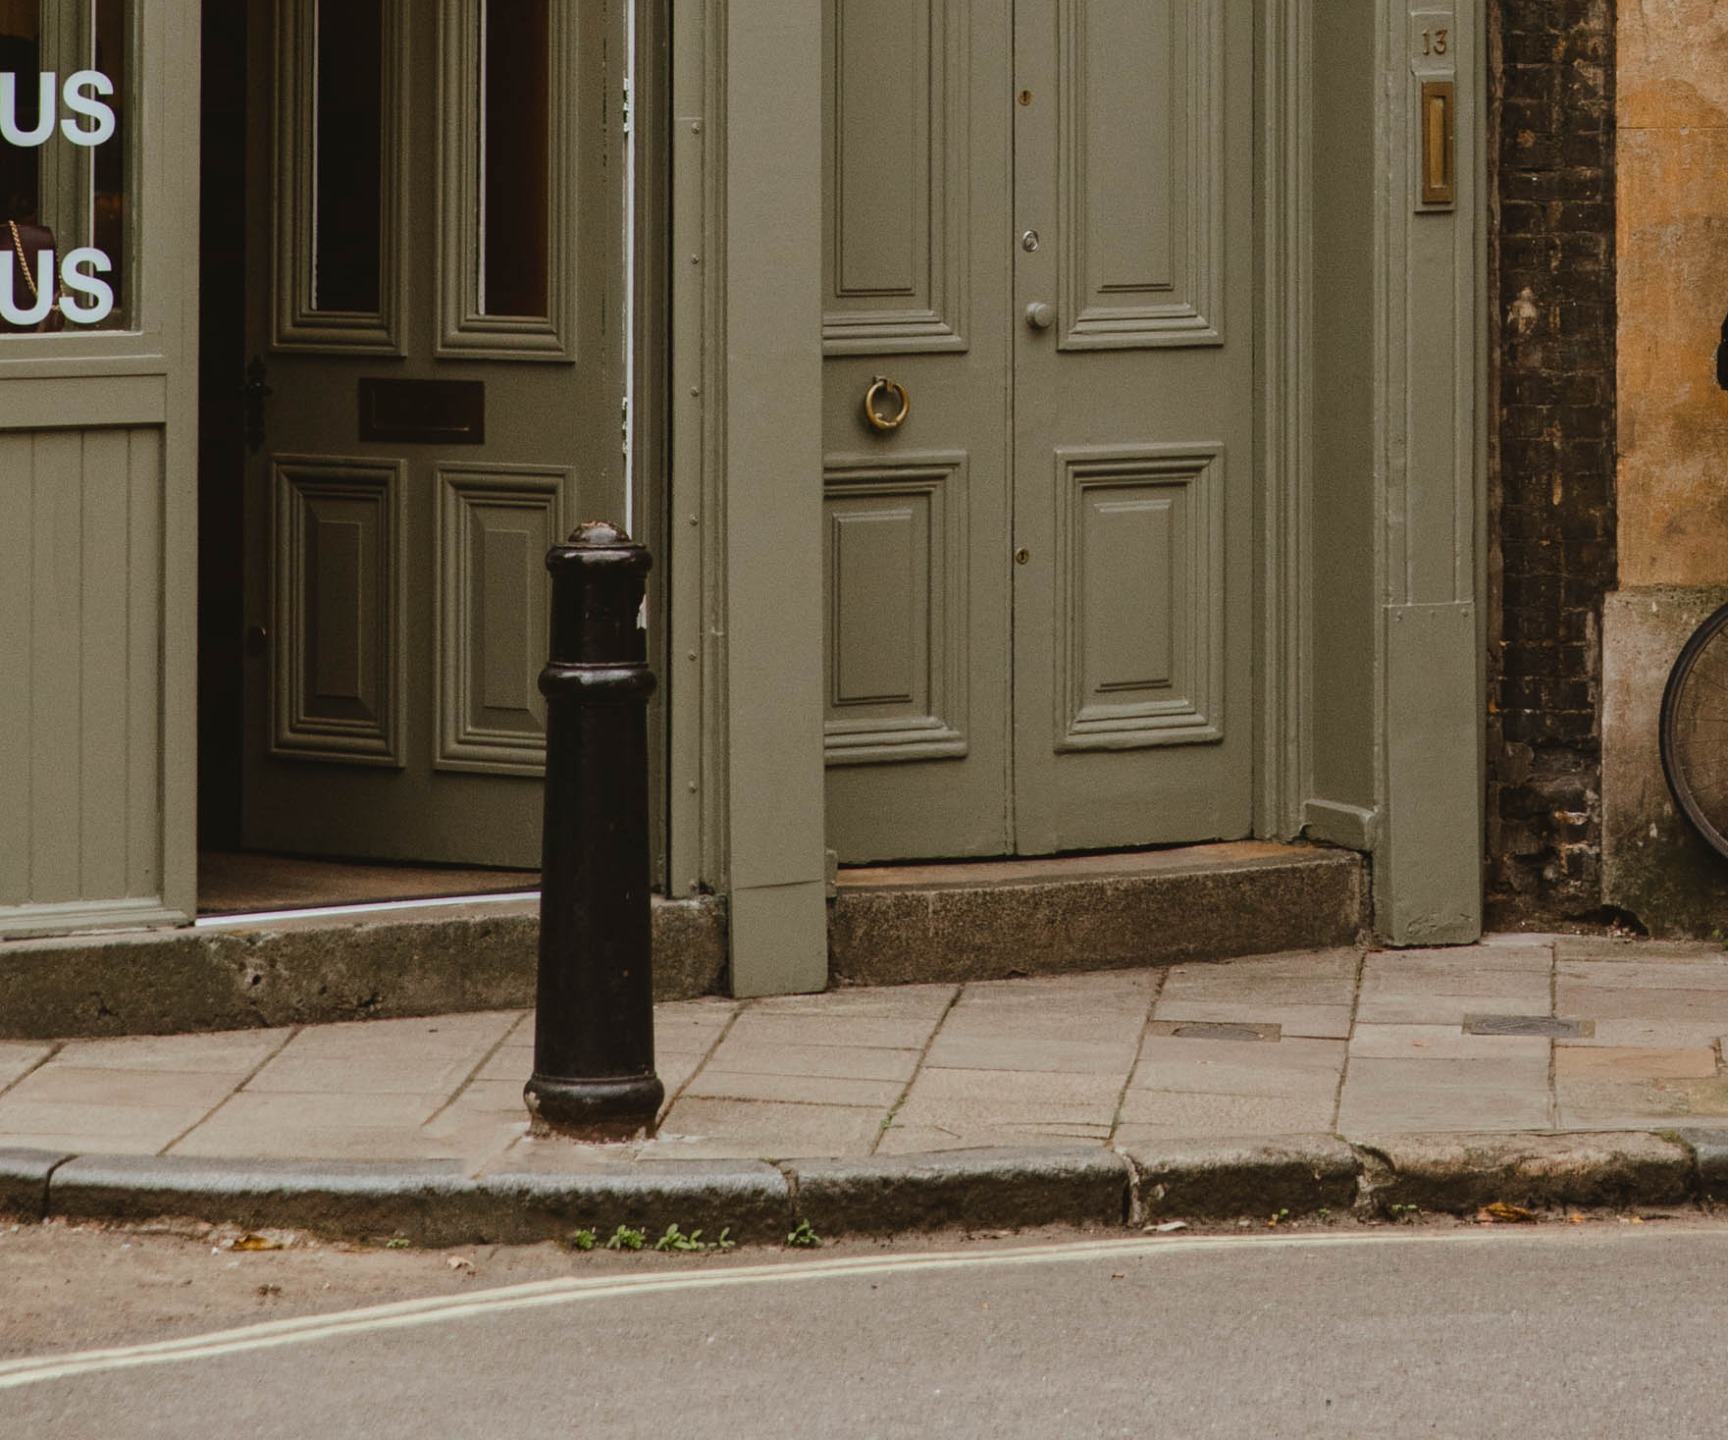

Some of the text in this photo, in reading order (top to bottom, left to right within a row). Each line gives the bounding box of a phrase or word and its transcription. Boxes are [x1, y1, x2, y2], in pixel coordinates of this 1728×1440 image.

[1422, 28, 1449, 56] 13
[0, 70, 116, 148] US
[0, 246, 115, 325] US
